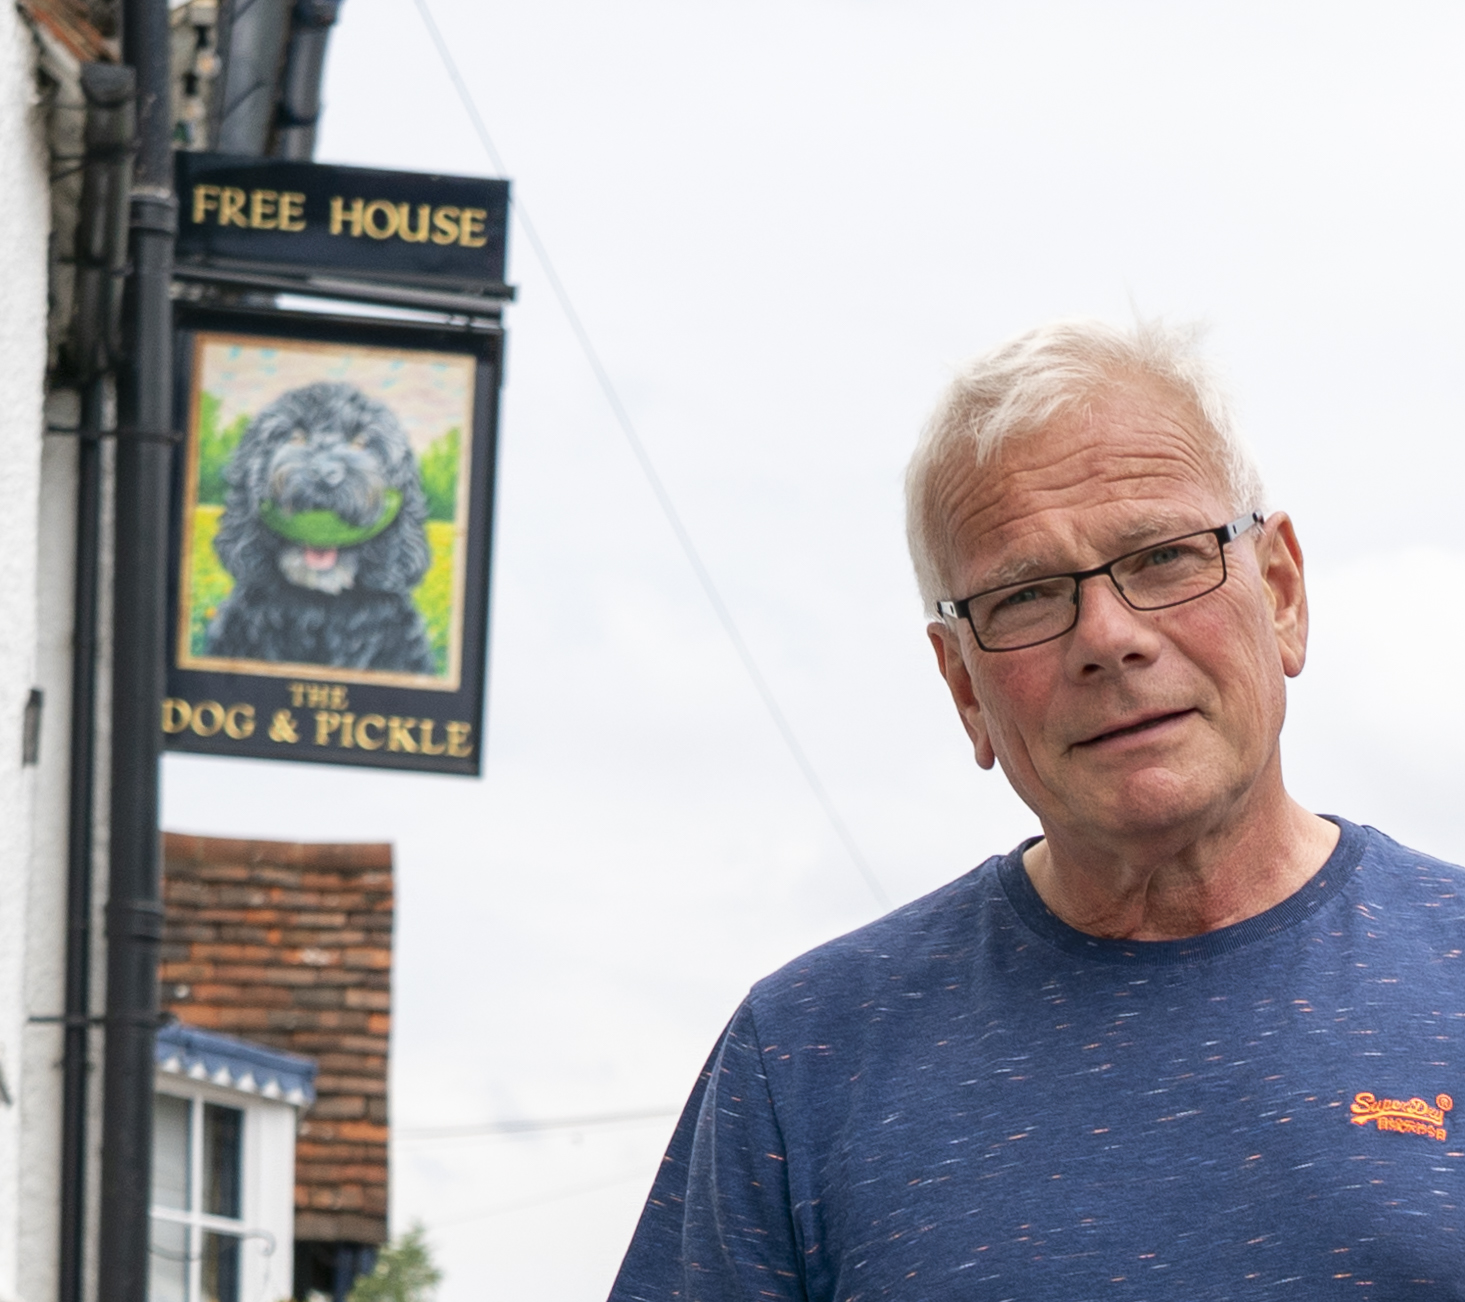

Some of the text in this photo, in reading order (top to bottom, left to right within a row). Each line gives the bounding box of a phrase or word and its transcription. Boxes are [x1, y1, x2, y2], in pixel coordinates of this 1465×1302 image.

[192, 184, 487, 248] FREE HOUSE
[290, 682, 348, 710] THE
[162, 698, 473, 757] DOG & PICKLE
